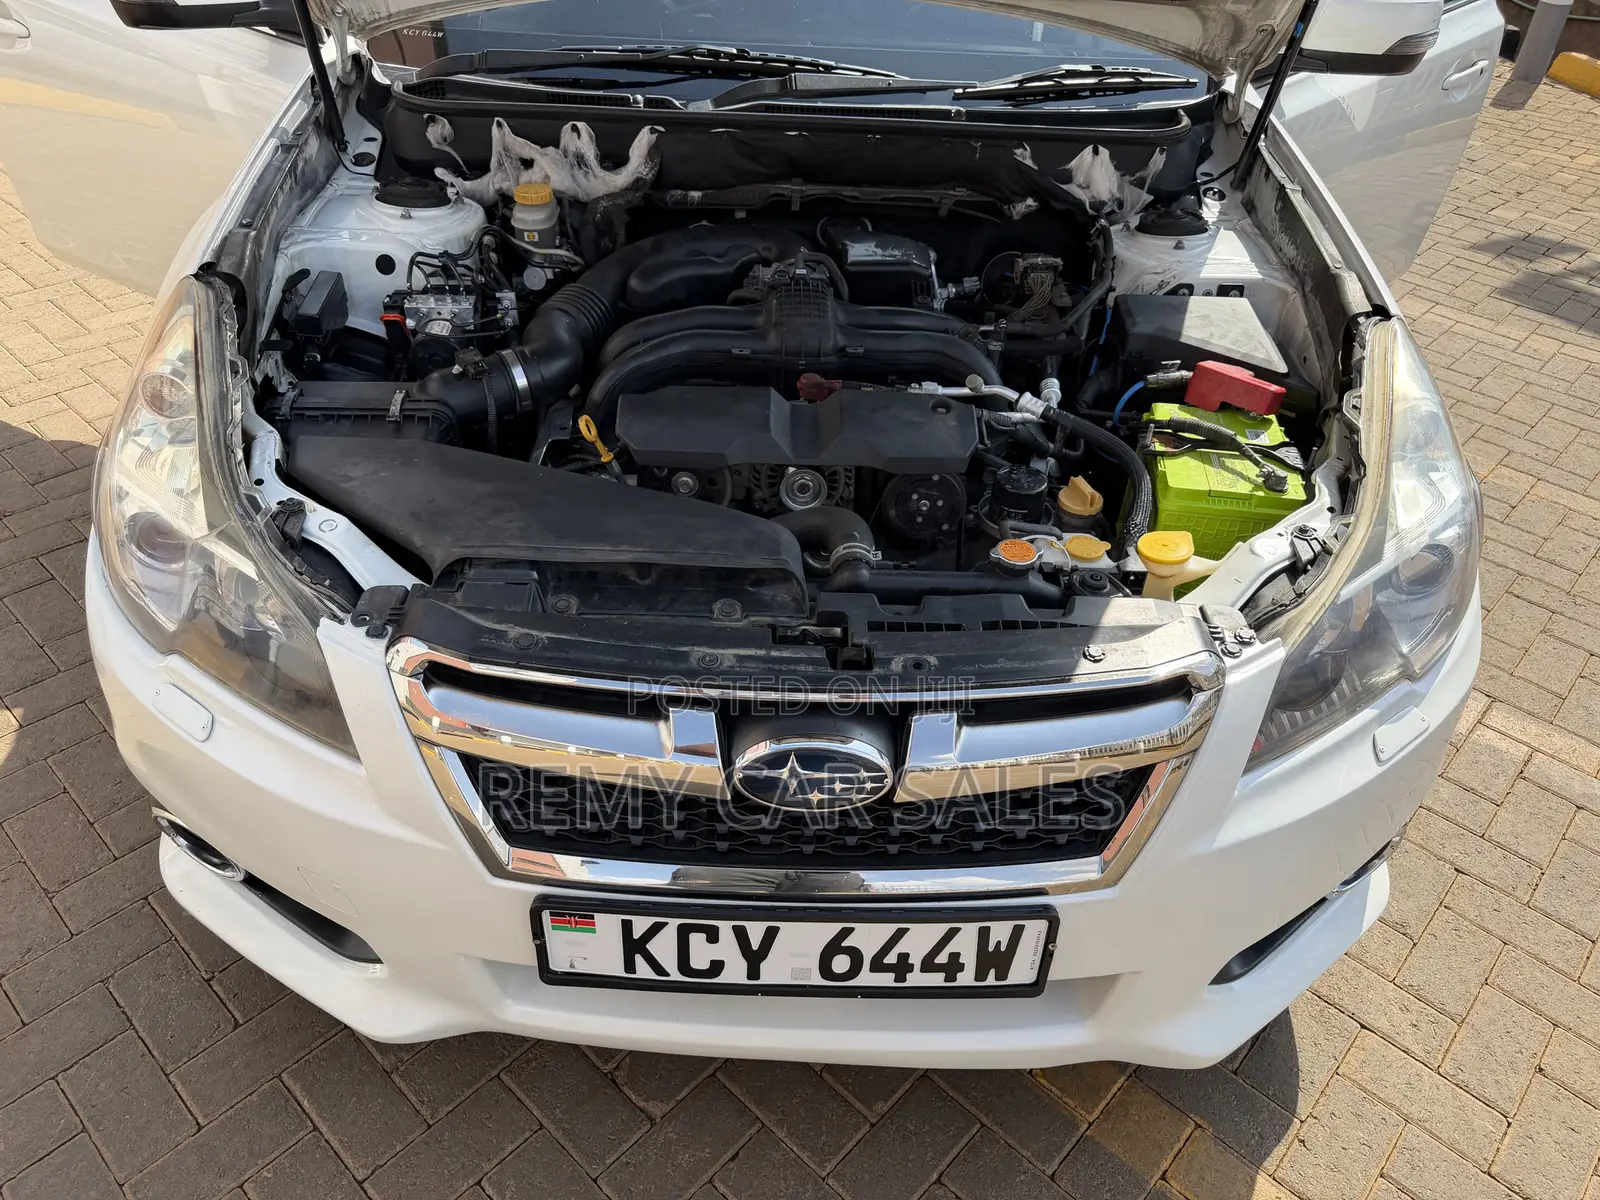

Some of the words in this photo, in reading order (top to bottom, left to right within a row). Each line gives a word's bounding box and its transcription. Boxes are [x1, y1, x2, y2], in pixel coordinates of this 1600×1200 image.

[402, 28, 421, 36] KCY
[621, 918, 781, 981] KCY
[818, 924, 1026, 983] 644W
